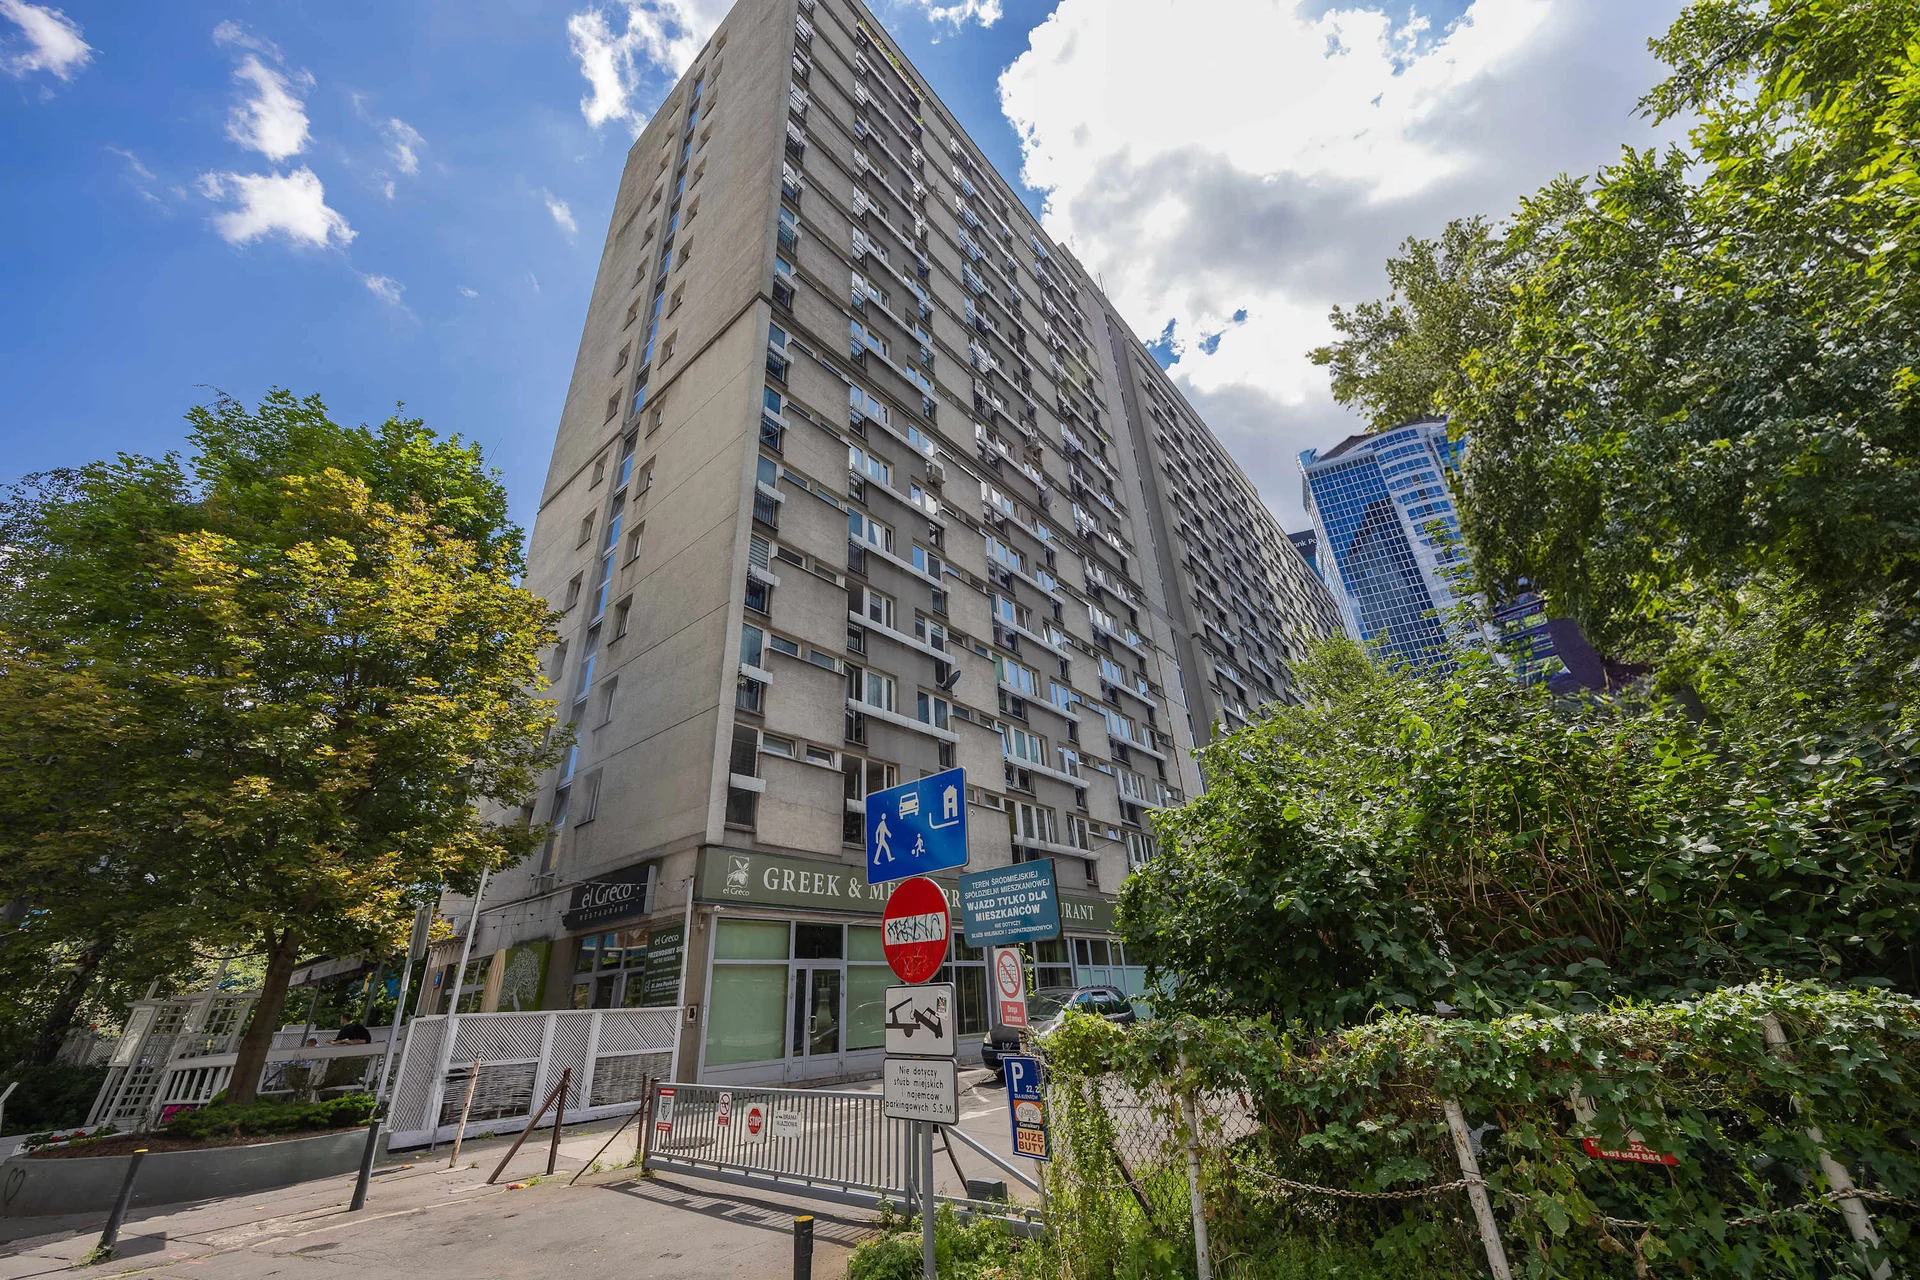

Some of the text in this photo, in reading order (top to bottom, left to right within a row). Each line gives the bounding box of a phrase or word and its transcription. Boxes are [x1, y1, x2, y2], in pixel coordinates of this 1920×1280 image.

[763, 867, 840, 896] GREEK
[848, 877, 862, 899] &
[972, 870, 1038, 889] TEREN ŚRÓDMIEJSKIEJ
[582, 884, 631, 908] el Greco
[731, 888, 750, 896] Greco
[965, 887, 999, 899] SPÓŁDZIELNI
[1000, 878, 1050, 893] MIESZKANIOWEJ
[967, 890, 1048, 911] WJAZD TYLKO DLA
[580, 904, 629, 920] RESTAURANT
[975, 904, 1040, 921] MIESZKAŃCÓW
[655, 934, 679, 945] el Greco
[899, 1066, 937, 1078] Nie dotyczy
[1011, 1062, 1024, 1092] P
[894, 1077, 944, 1089] służb miejskich
[886, 1100, 954, 1114] parkingowych S.S.M.
[749, 1116, 761, 1126] STOP
[1018, 1130, 1044, 1143] DUŻE
[1018, 1141, 1044, 1153] BUTY
